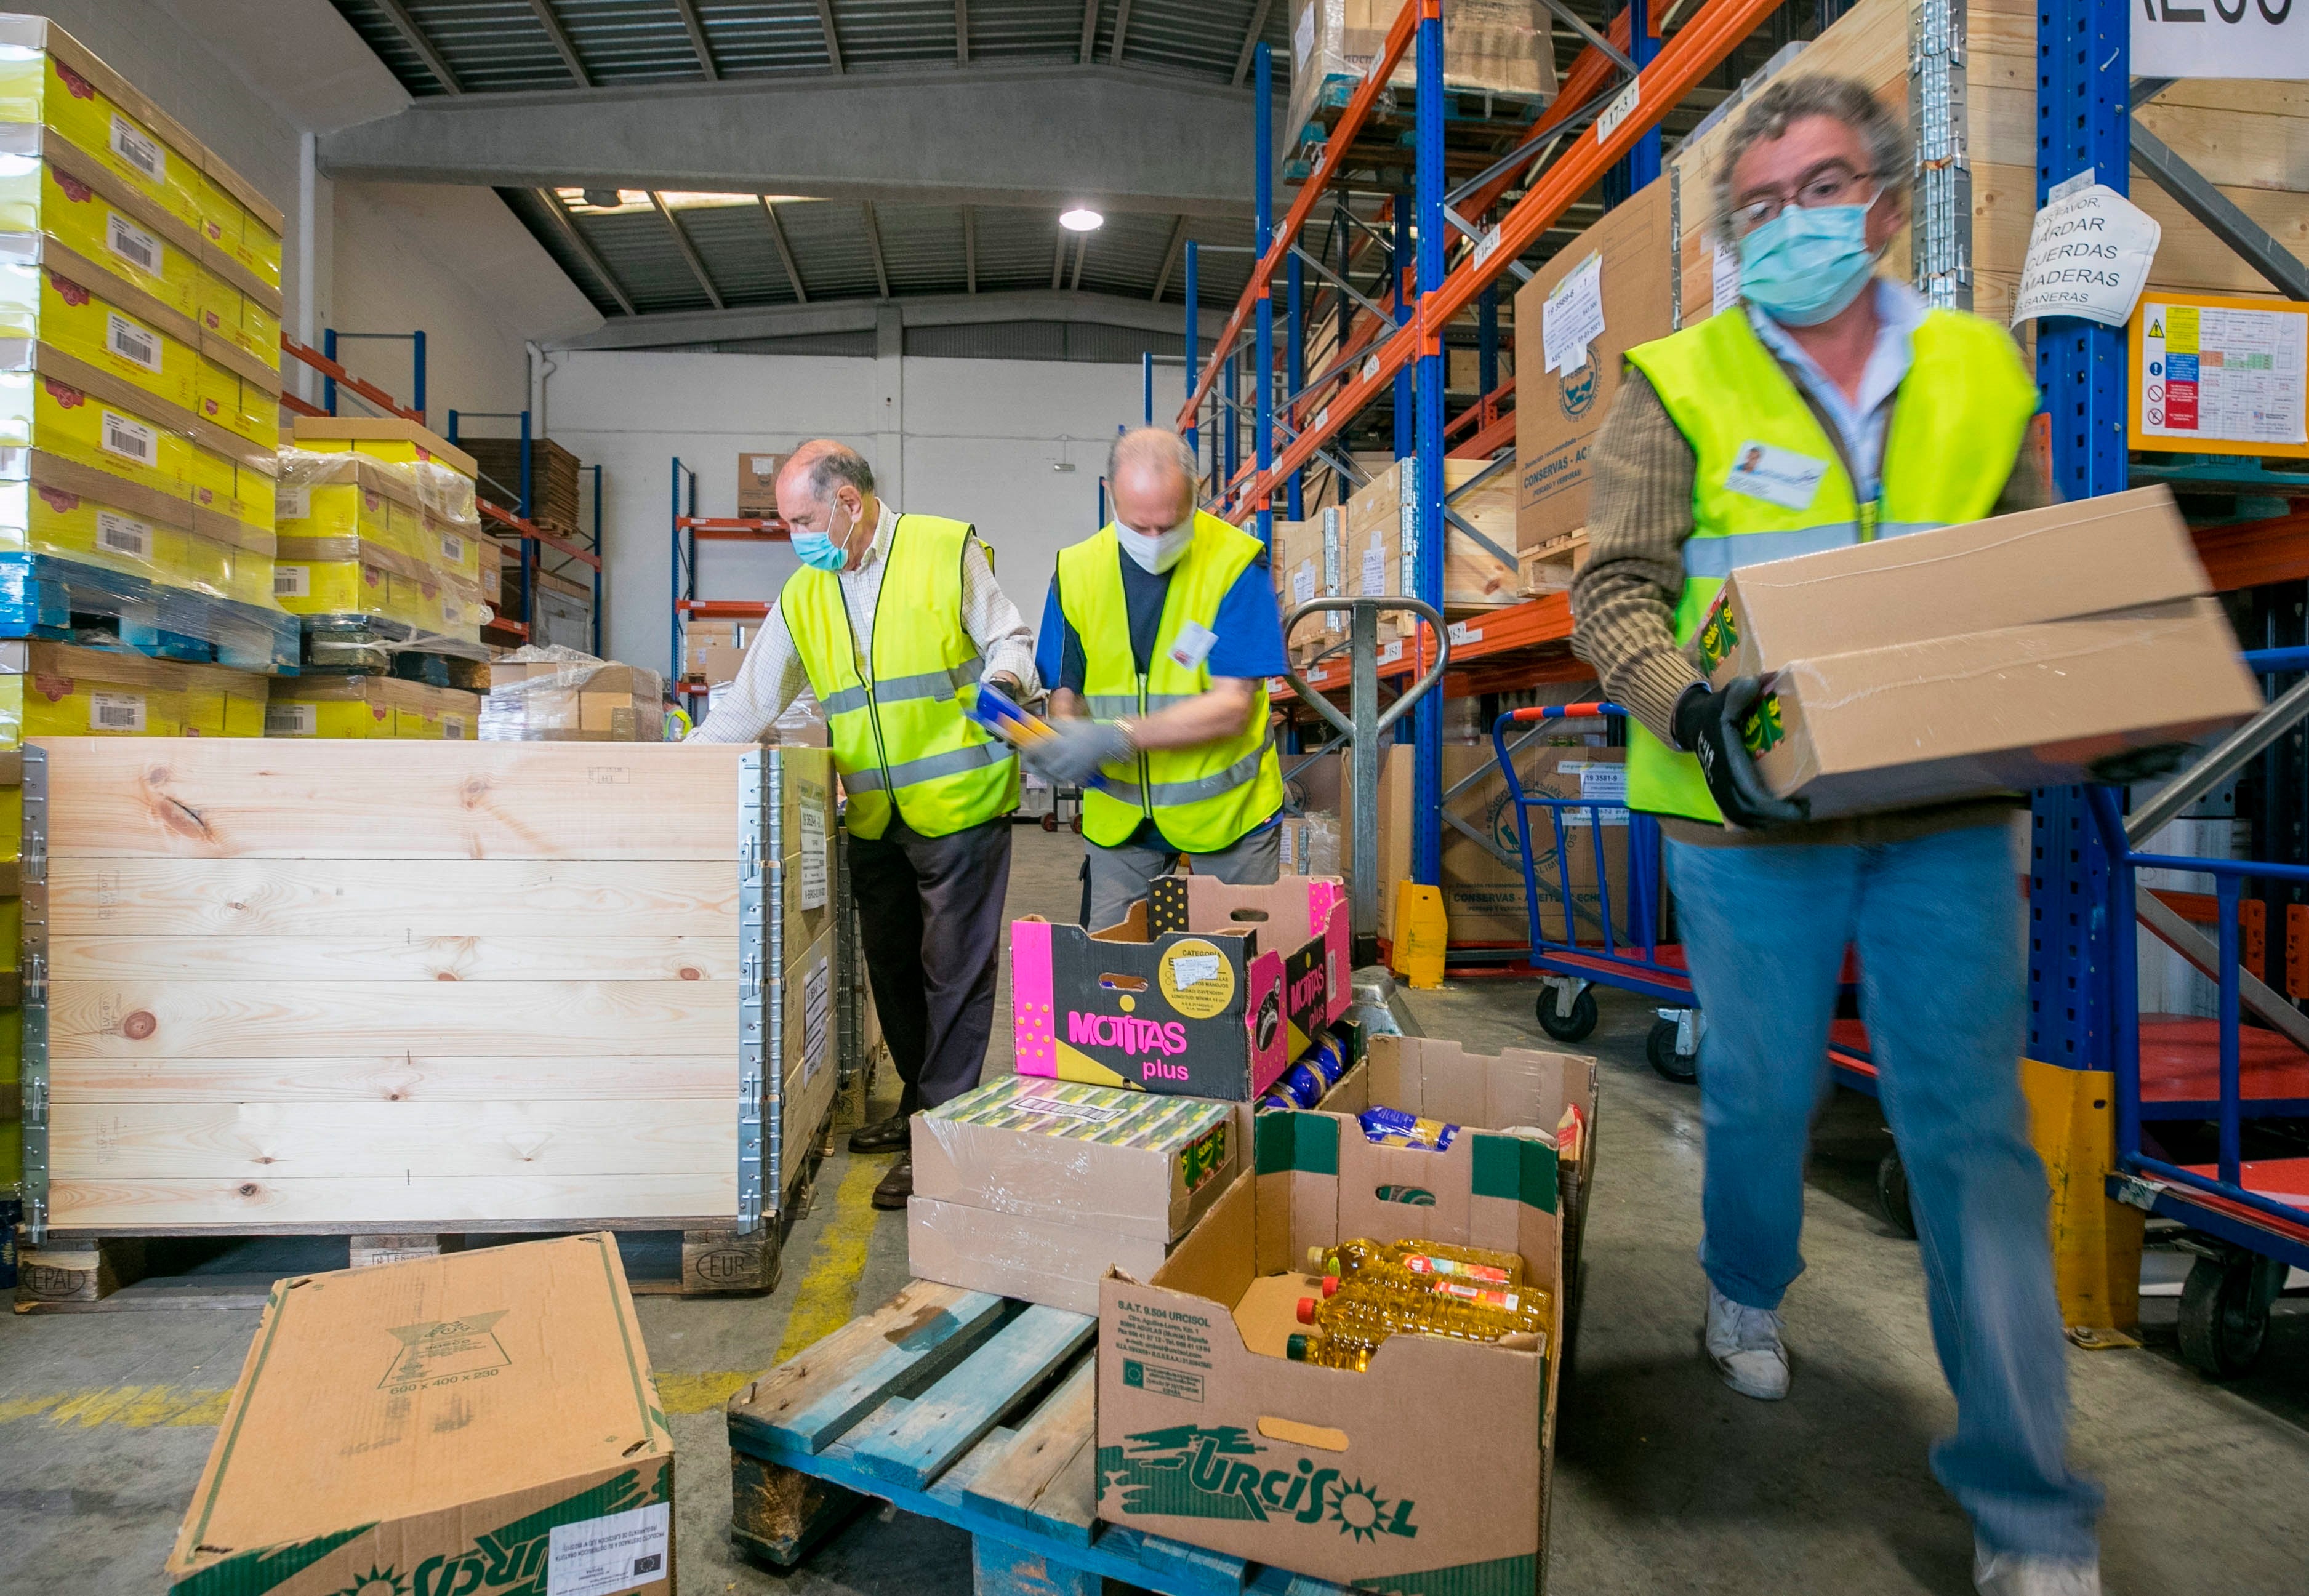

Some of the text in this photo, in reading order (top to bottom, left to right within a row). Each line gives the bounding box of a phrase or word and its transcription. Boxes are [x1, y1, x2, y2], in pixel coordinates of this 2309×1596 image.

[2030, 217, 2105, 251] UARDAR
[2022, 268, 2120, 294] MADERAS
[1524, 455, 1568, 489] CONSERVAS
[1453, 893, 1516, 903] CONSERVAS
[1068, 1011, 1188, 1057] MOTITAS
[1142, 1058, 1189, 1081] plus
[710, 1256, 744, 1277] EUR
[34, 1267, 76, 1290] EPAL
[1118, 1300, 1211, 1328] S.A.T. 9.504 URCISOL
[390, 1384, 417, 1395] 600
[432, 1375, 459, 1386] 400
[473, 1368, 499, 1379] 230
[619, 1537, 641, 1547] DESTINADO
[642, 1531, 664, 1541] PRODUCTO
[556, 1552, 577, 1561] GRATUITA
